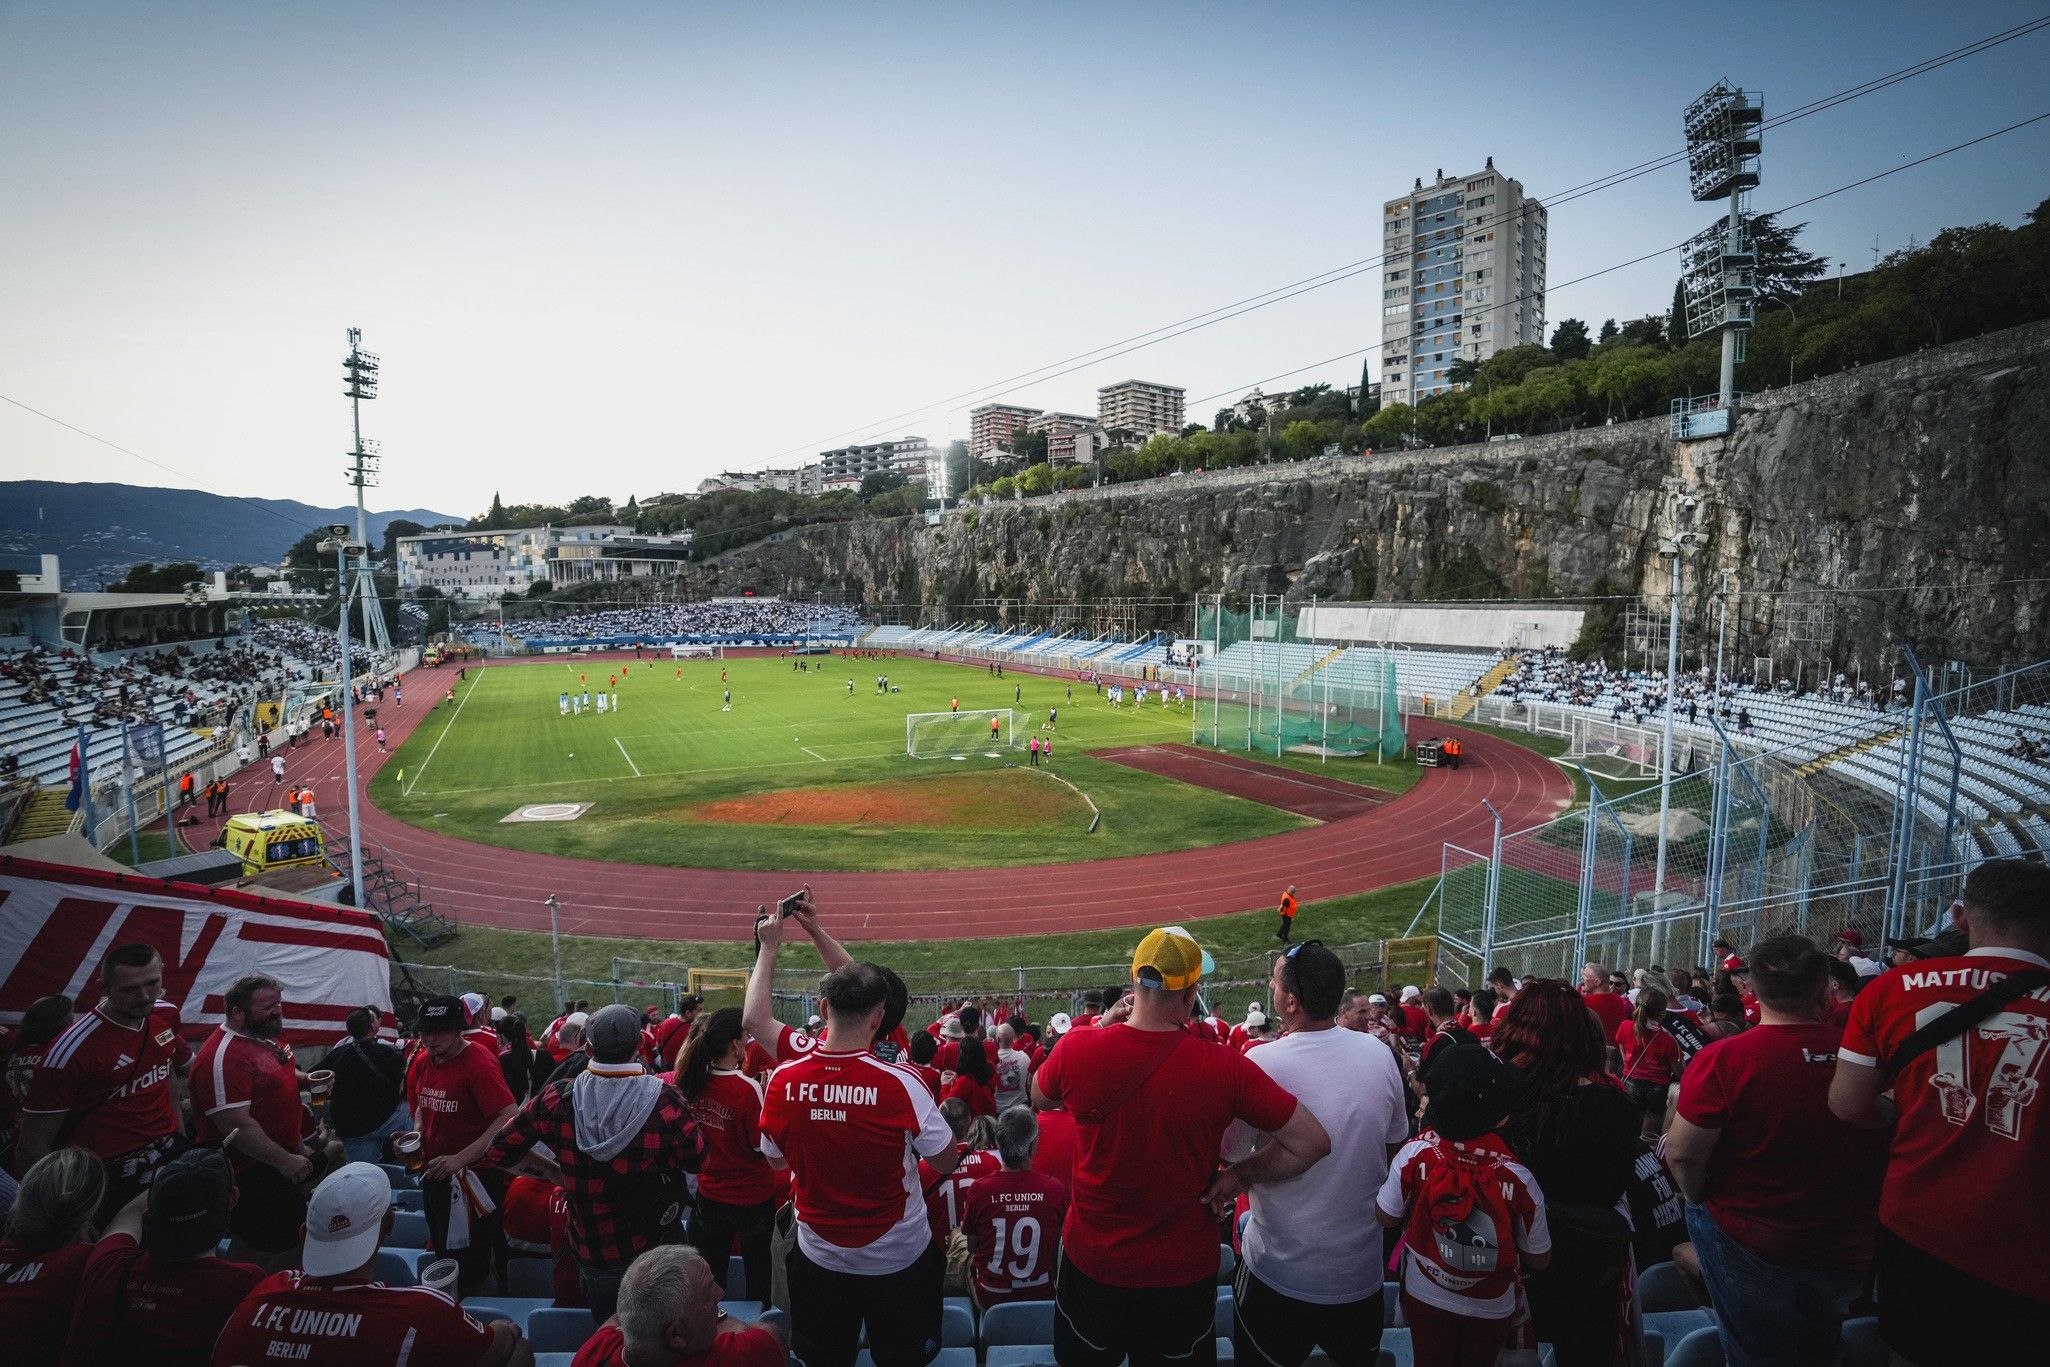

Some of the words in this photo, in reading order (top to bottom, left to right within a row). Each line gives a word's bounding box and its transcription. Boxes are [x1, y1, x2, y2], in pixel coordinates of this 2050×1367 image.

[1677, 1025, 1688, 1035] FC
[1685, 1033, 1704, 1051] UNIO
[131, 1058, 171, 1094] raisi
[785, 1082, 795, 1101] 1.
[799, 1083, 819, 1102] FC
[823, 1084, 878, 1106] UNION
[810, 1108, 847, 1122] BERLIN
[960, 1154, 982, 1166] NION
[991, 1195, 998, 1204] 1.
[999, 1193, 1012, 1203] FC
[1014, 1193, 1044, 1202] UNION
[1005, 1204, 1030, 1212] BERLIN
[987, 1216, 1041, 1279] 19
[251, 1303, 268, 1327] 1.
[265, 1305, 291, 1331] FC
[289, 1309, 363, 1337] UNION
[266, 1340, 312, 1361] BERLIN
